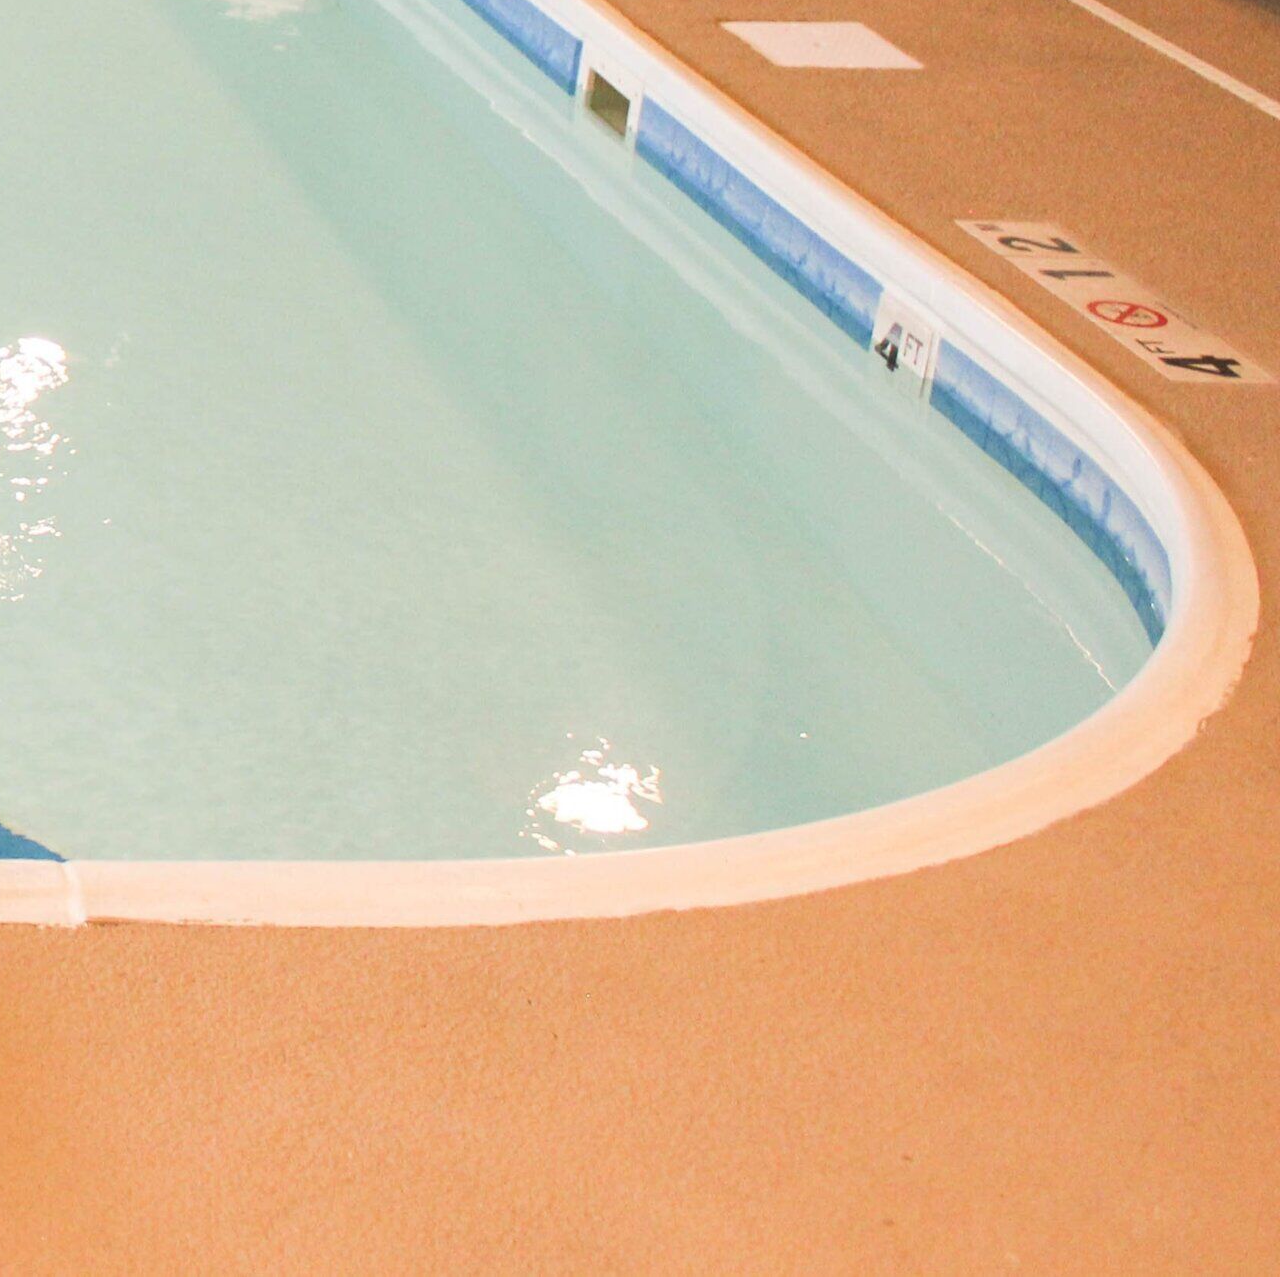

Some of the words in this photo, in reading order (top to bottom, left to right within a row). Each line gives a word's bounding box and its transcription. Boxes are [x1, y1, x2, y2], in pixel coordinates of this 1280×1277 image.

[874, 321, 903, 373] 4
[903, 332, 924, 366] FT
[1135, 338, 1176, 354] FT
[1158, 354, 1242, 378] 4
